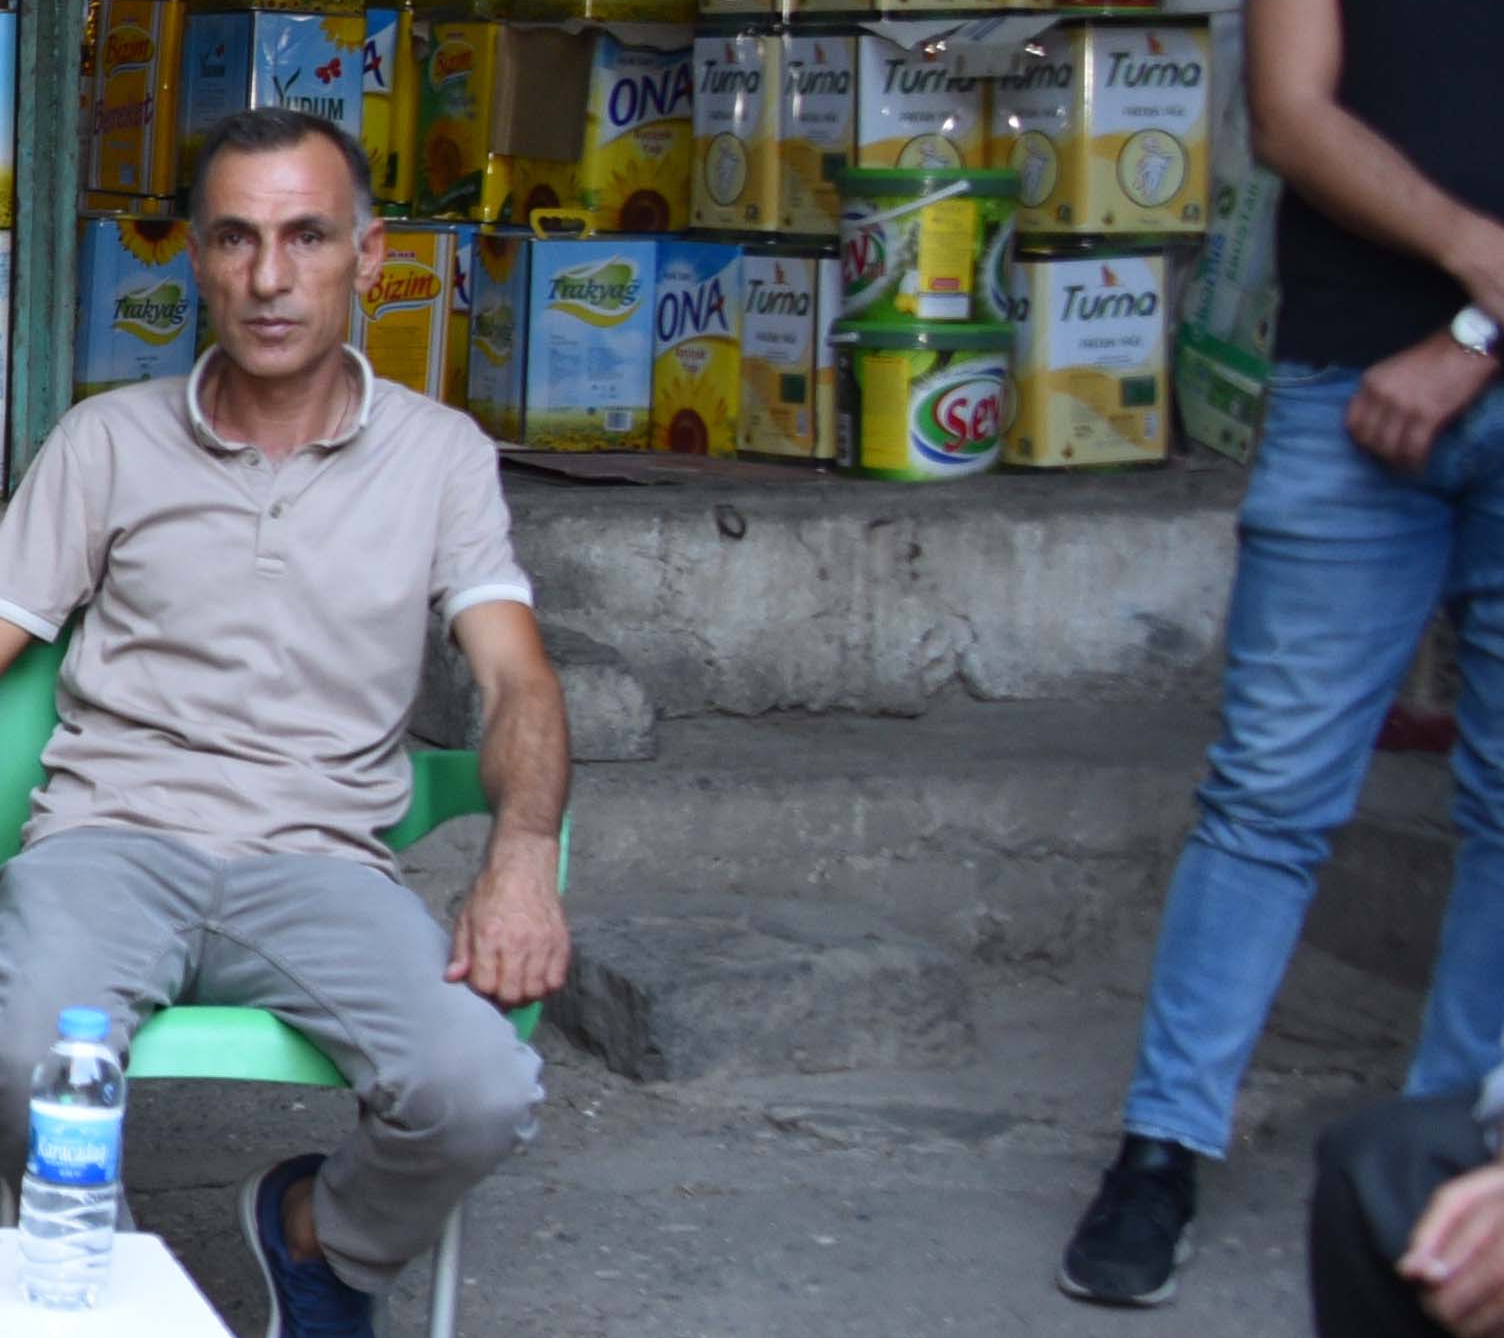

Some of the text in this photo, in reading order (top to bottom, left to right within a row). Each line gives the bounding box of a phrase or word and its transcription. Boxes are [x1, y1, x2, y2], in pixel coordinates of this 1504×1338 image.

[699, 60, 760, 94] Turna
[1104, 51, 1202, 88] Turna
[609, 63, 693, 127] ONA
[367, 270, 435, 302] Bizim
[745, 279, 810, 317] Turna
[1060, 284, 1158, 322] Turna
[657, 278, 729, 342] ONA
